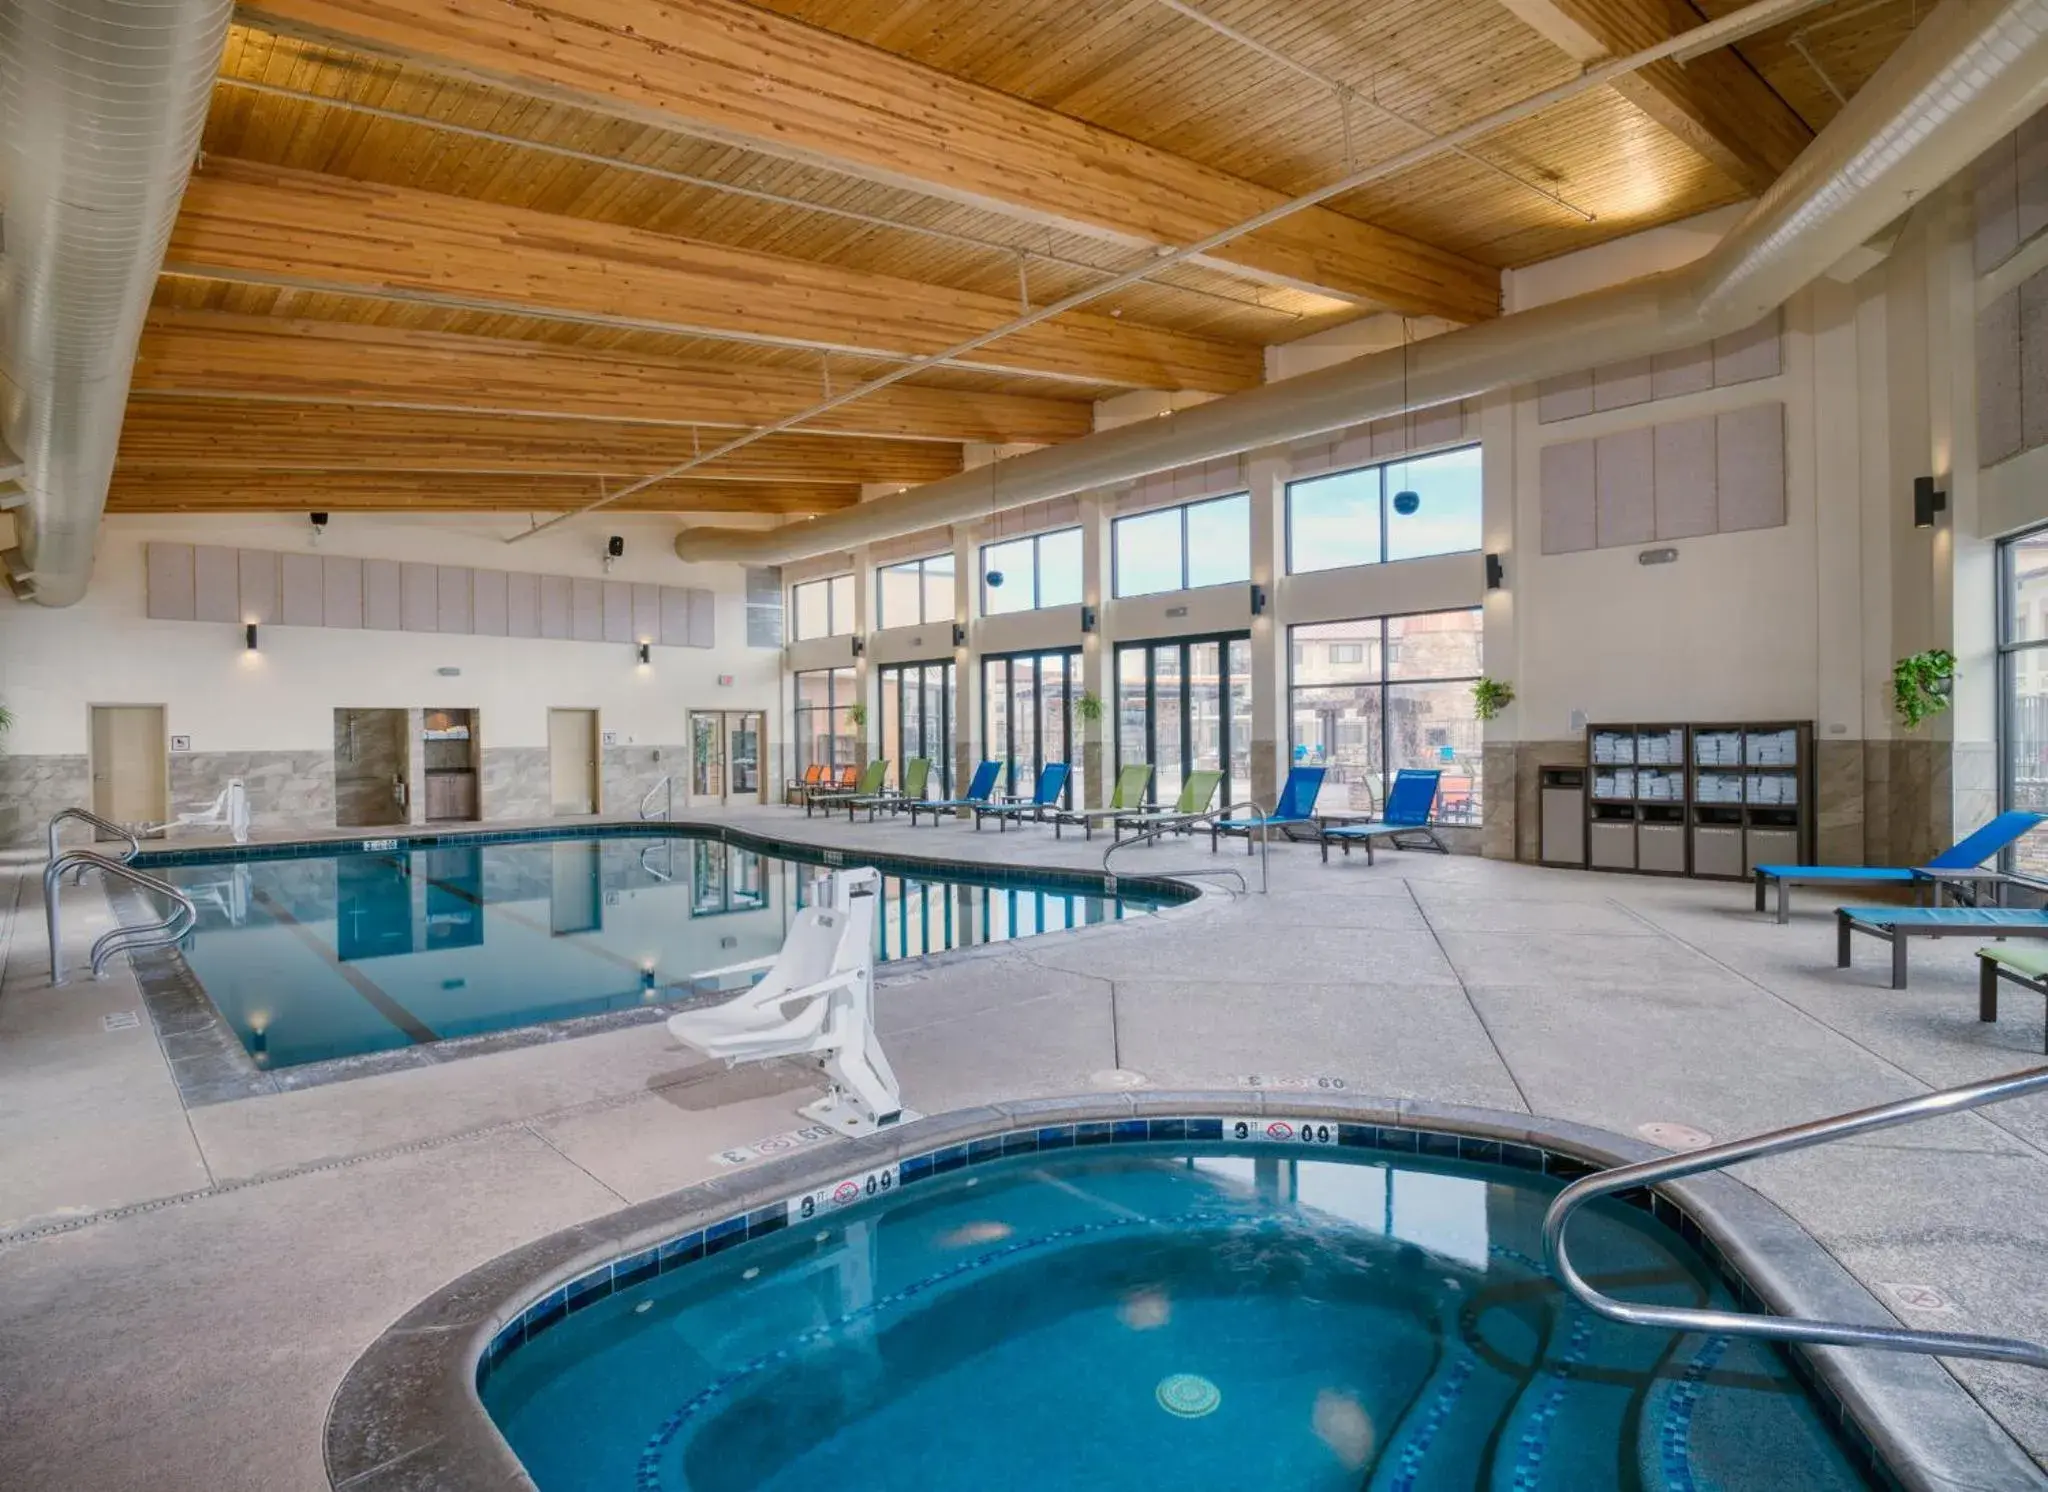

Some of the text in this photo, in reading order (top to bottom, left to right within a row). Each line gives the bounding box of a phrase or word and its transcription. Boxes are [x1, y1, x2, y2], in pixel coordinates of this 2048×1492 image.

[1234, 1121, 1249, 1139] 3
[1301, 1124, 1329, 1143] 09
[801, 1196, 815, 1218] 3
[866, 1170, 892, 1195] 09
